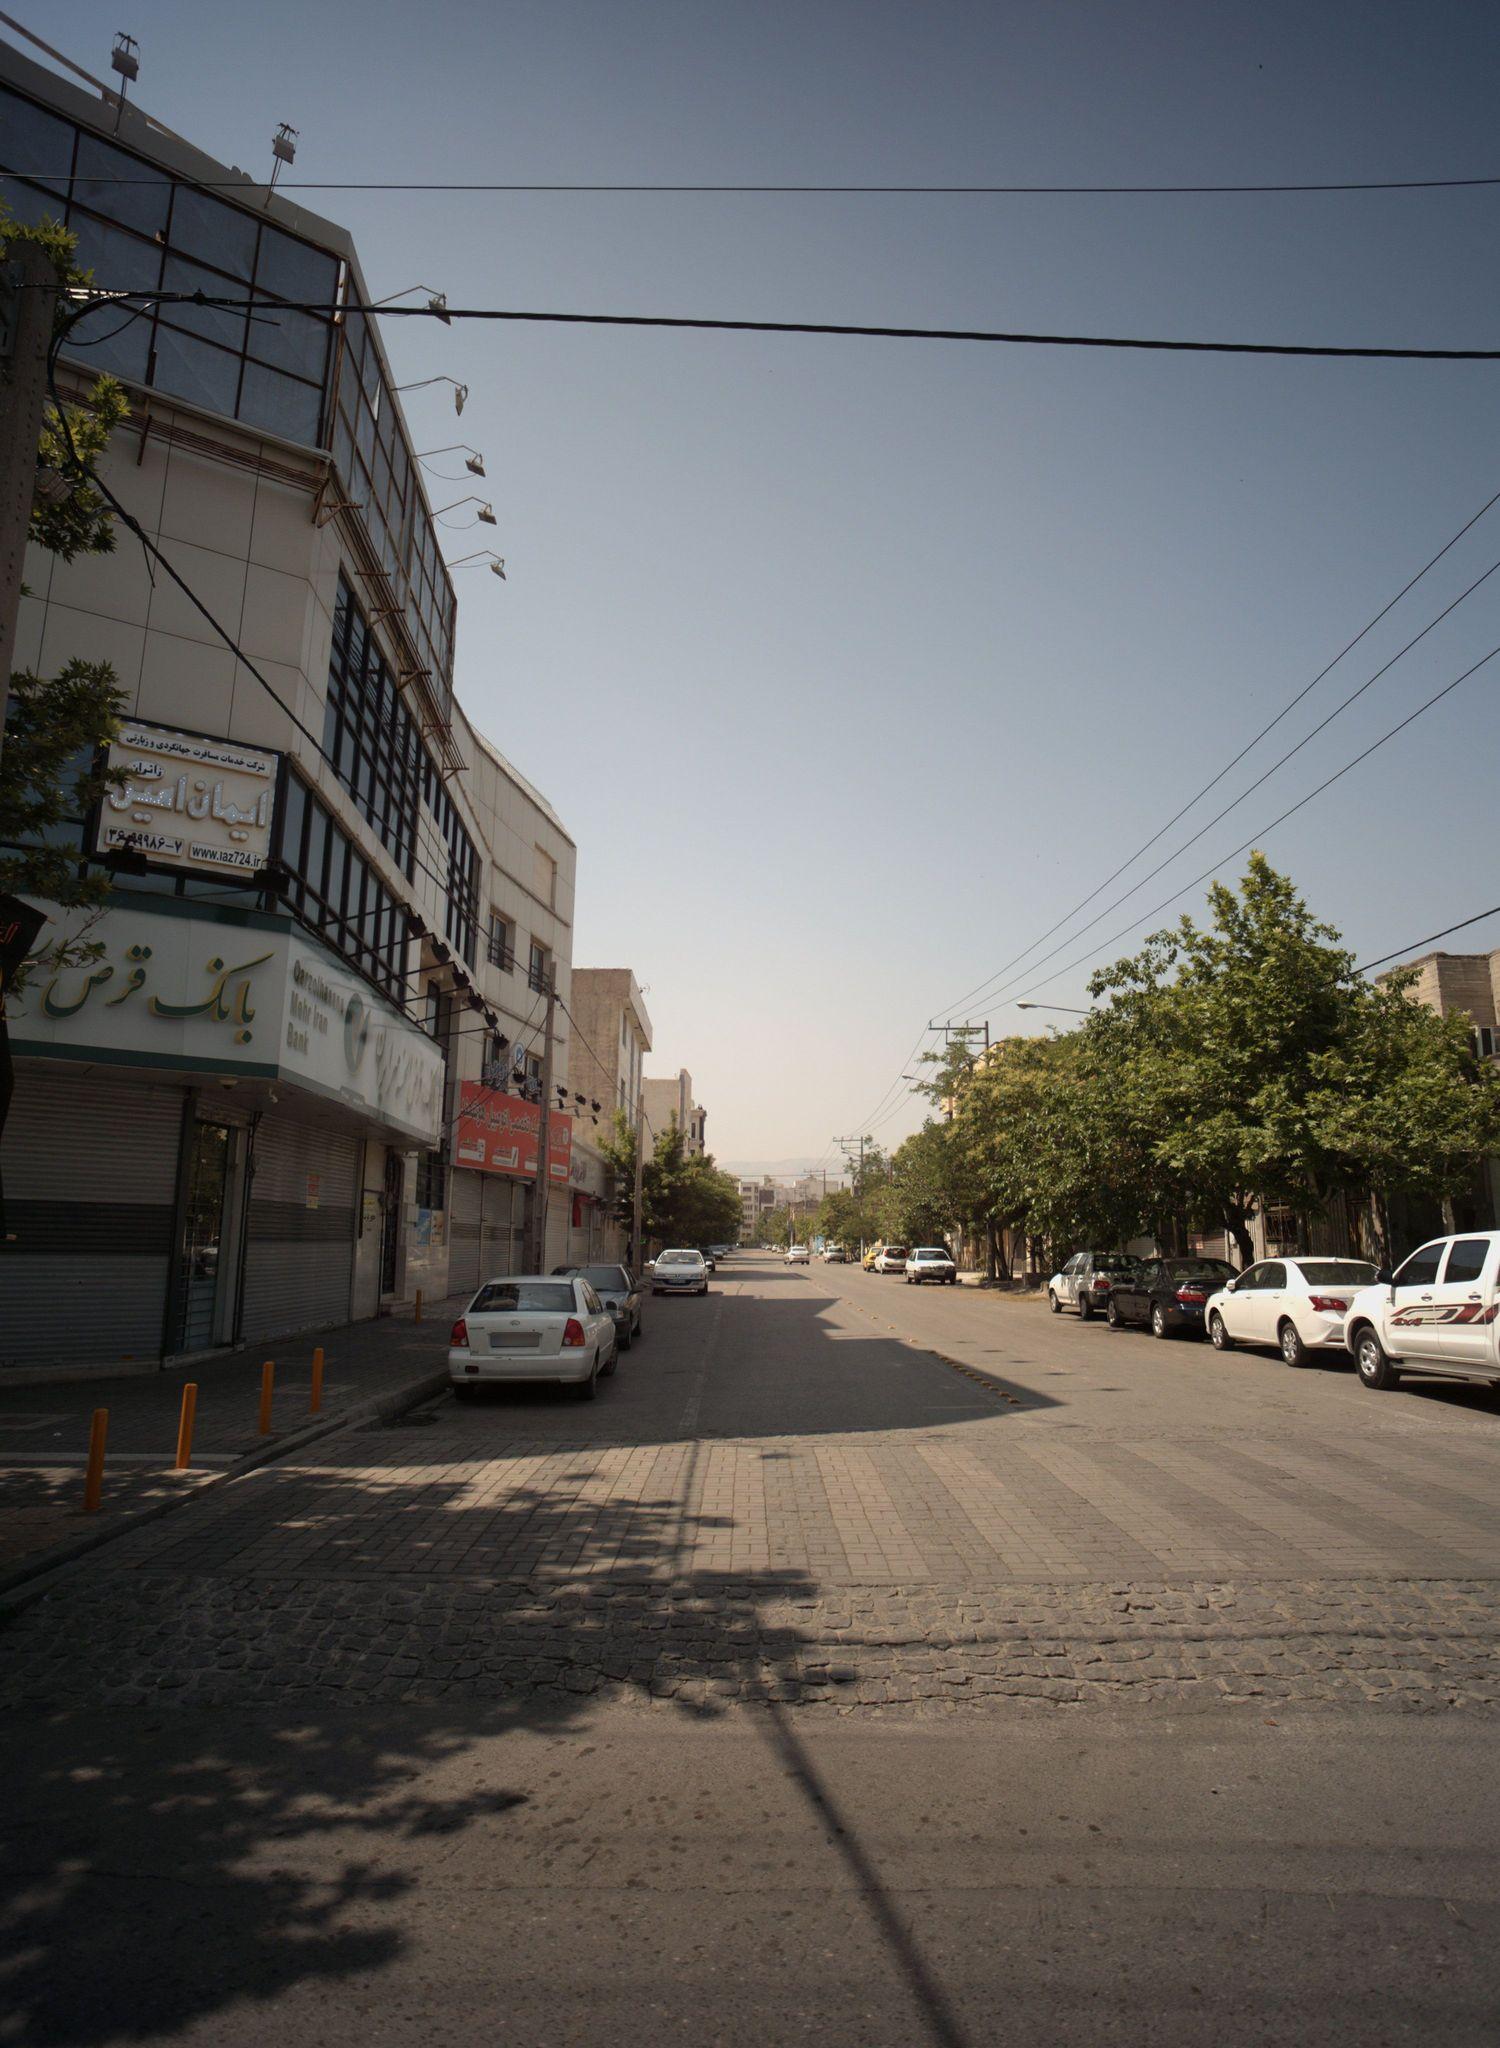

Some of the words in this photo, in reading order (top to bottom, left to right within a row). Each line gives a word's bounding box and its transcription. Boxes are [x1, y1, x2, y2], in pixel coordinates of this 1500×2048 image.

[126, 734, 149, 746] زیارتی
[155, 741, 191, 754] جهانگردی
[193, 749, 219, 761] مسافرت
[220, 754, 244, 766] خدمات
[246, 760, 266, 772] شرکت
[109, 775, 187, 823] امین
[187, 779, 270, 841] ایمان
[192, 846, 261, 867] www.iaz724.ir
[41, 941, 152, 1018] قرض
[150, 952, 276, 1045] بانک
[287, 1021, 308, 1056] Bank
